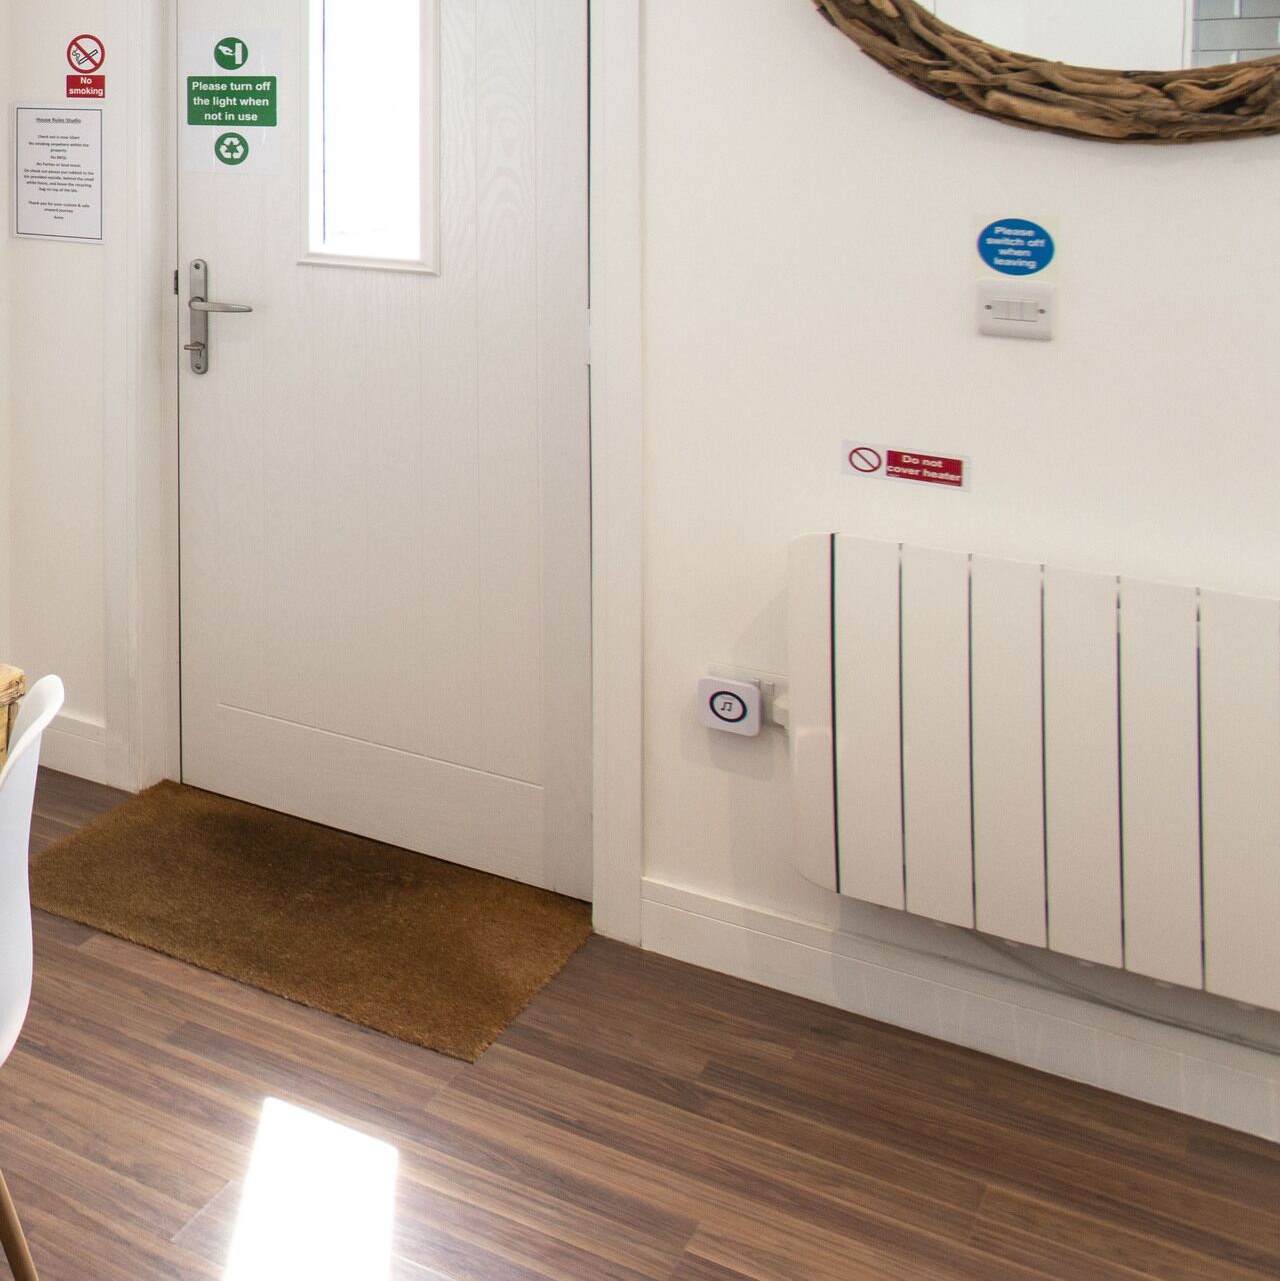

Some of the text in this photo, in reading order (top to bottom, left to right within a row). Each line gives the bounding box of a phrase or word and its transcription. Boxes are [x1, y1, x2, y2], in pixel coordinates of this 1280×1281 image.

[80, 76, 92, 85] No
[191, 81, 272, 91] Please turn off
[68, 86, 104, 97] smoking
[192, 96, 270, 108] the light when
[204, 111, 258, 121] not in use
[993, 226, 1035, 237] Please
[985, 237, 1046, 247] switch off
[993, 257, 1038, 269] leaving
[901, 455, 944, 468] Do not
[887, 465, 962, 482] cover heater
